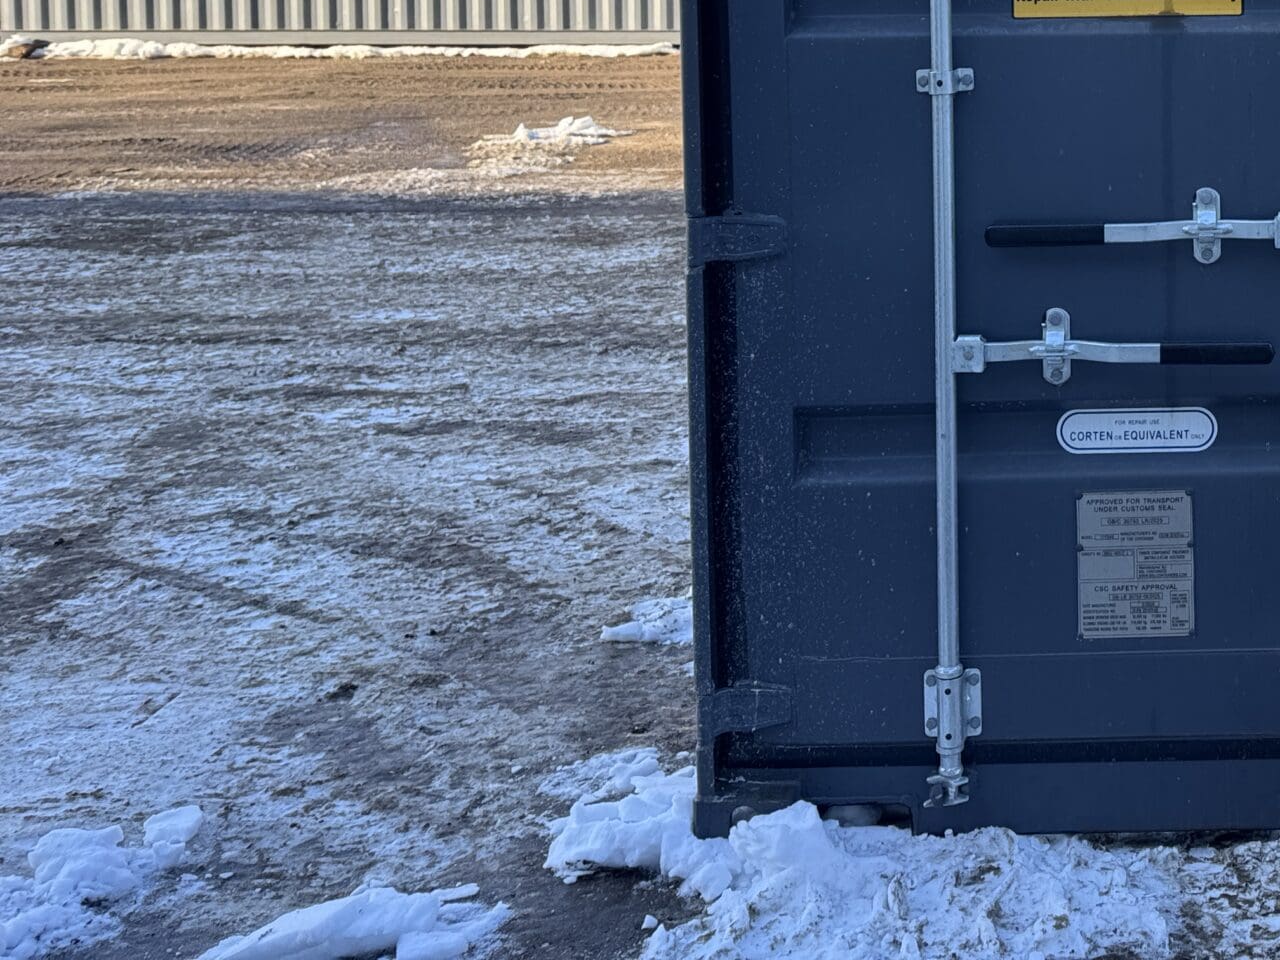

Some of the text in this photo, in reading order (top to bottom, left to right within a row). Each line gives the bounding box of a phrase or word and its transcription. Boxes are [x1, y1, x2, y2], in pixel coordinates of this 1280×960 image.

[1069, 431, 1113, 441] CORTEN
[1123, 429, 1190, 441] EQUIVALENT
[1126, 497, 1140, 505] FOR
[1143, 496, 1184, 504] TRANSPORT
[1093, 505, 1118, 513] UNDER
[1111, 584, 1138, 592] SAFETY
[1141, 583, 1177, 591] APPROVAL
